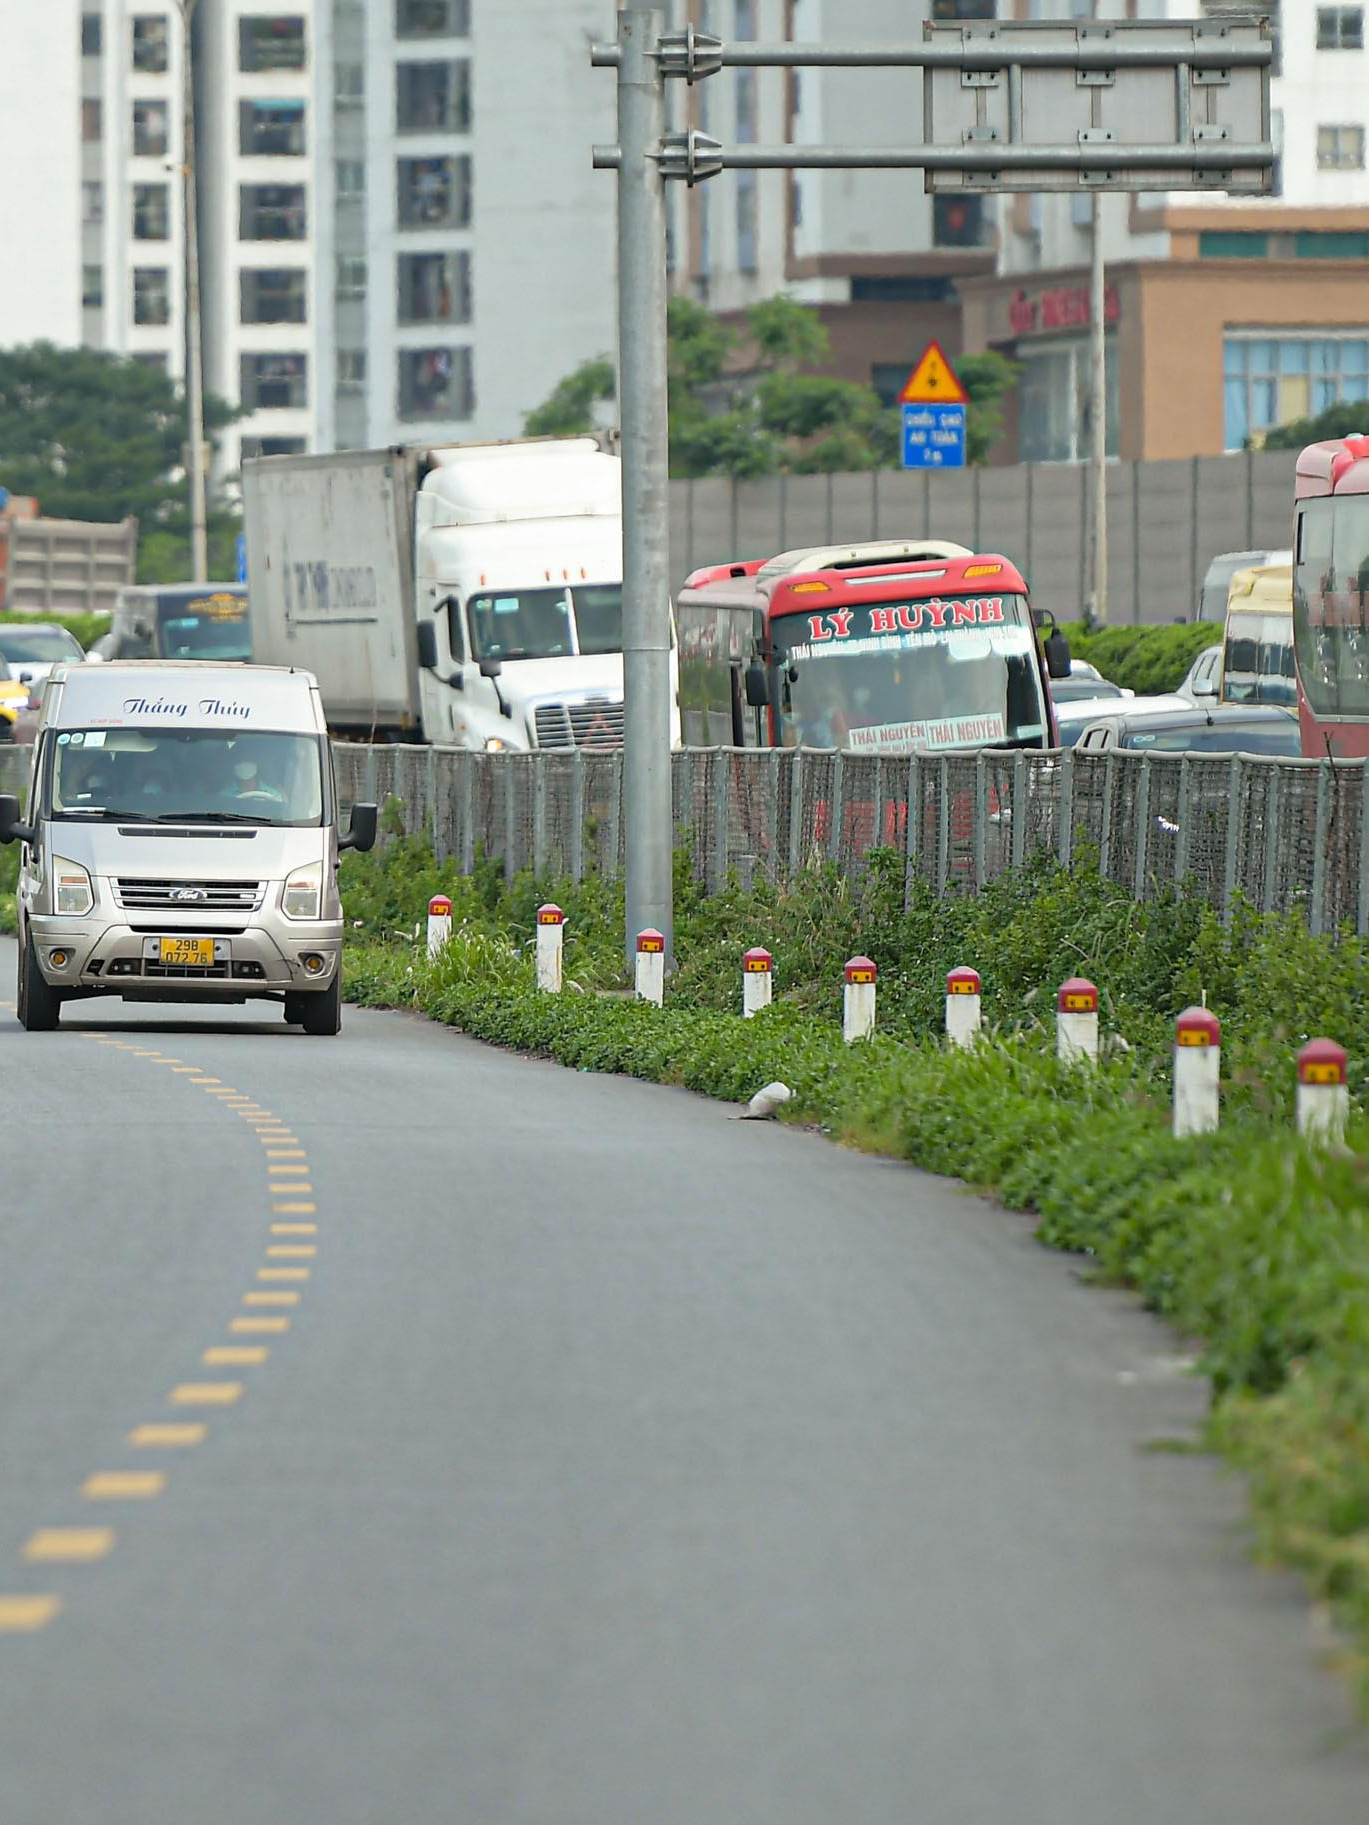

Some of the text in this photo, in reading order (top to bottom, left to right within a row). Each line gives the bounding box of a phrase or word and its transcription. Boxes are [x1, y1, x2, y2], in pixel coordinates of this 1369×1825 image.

[808, 597, 1005, 640] LÝ HUỲNH
[123, 697, 252, 719] Thắng Thúy
[853, 722, 926, 745] THÁI NGUYÊN
[930, 716, 1002, 744] THÁI NGUYÊN
[175, 940, 199, 951] 29B
